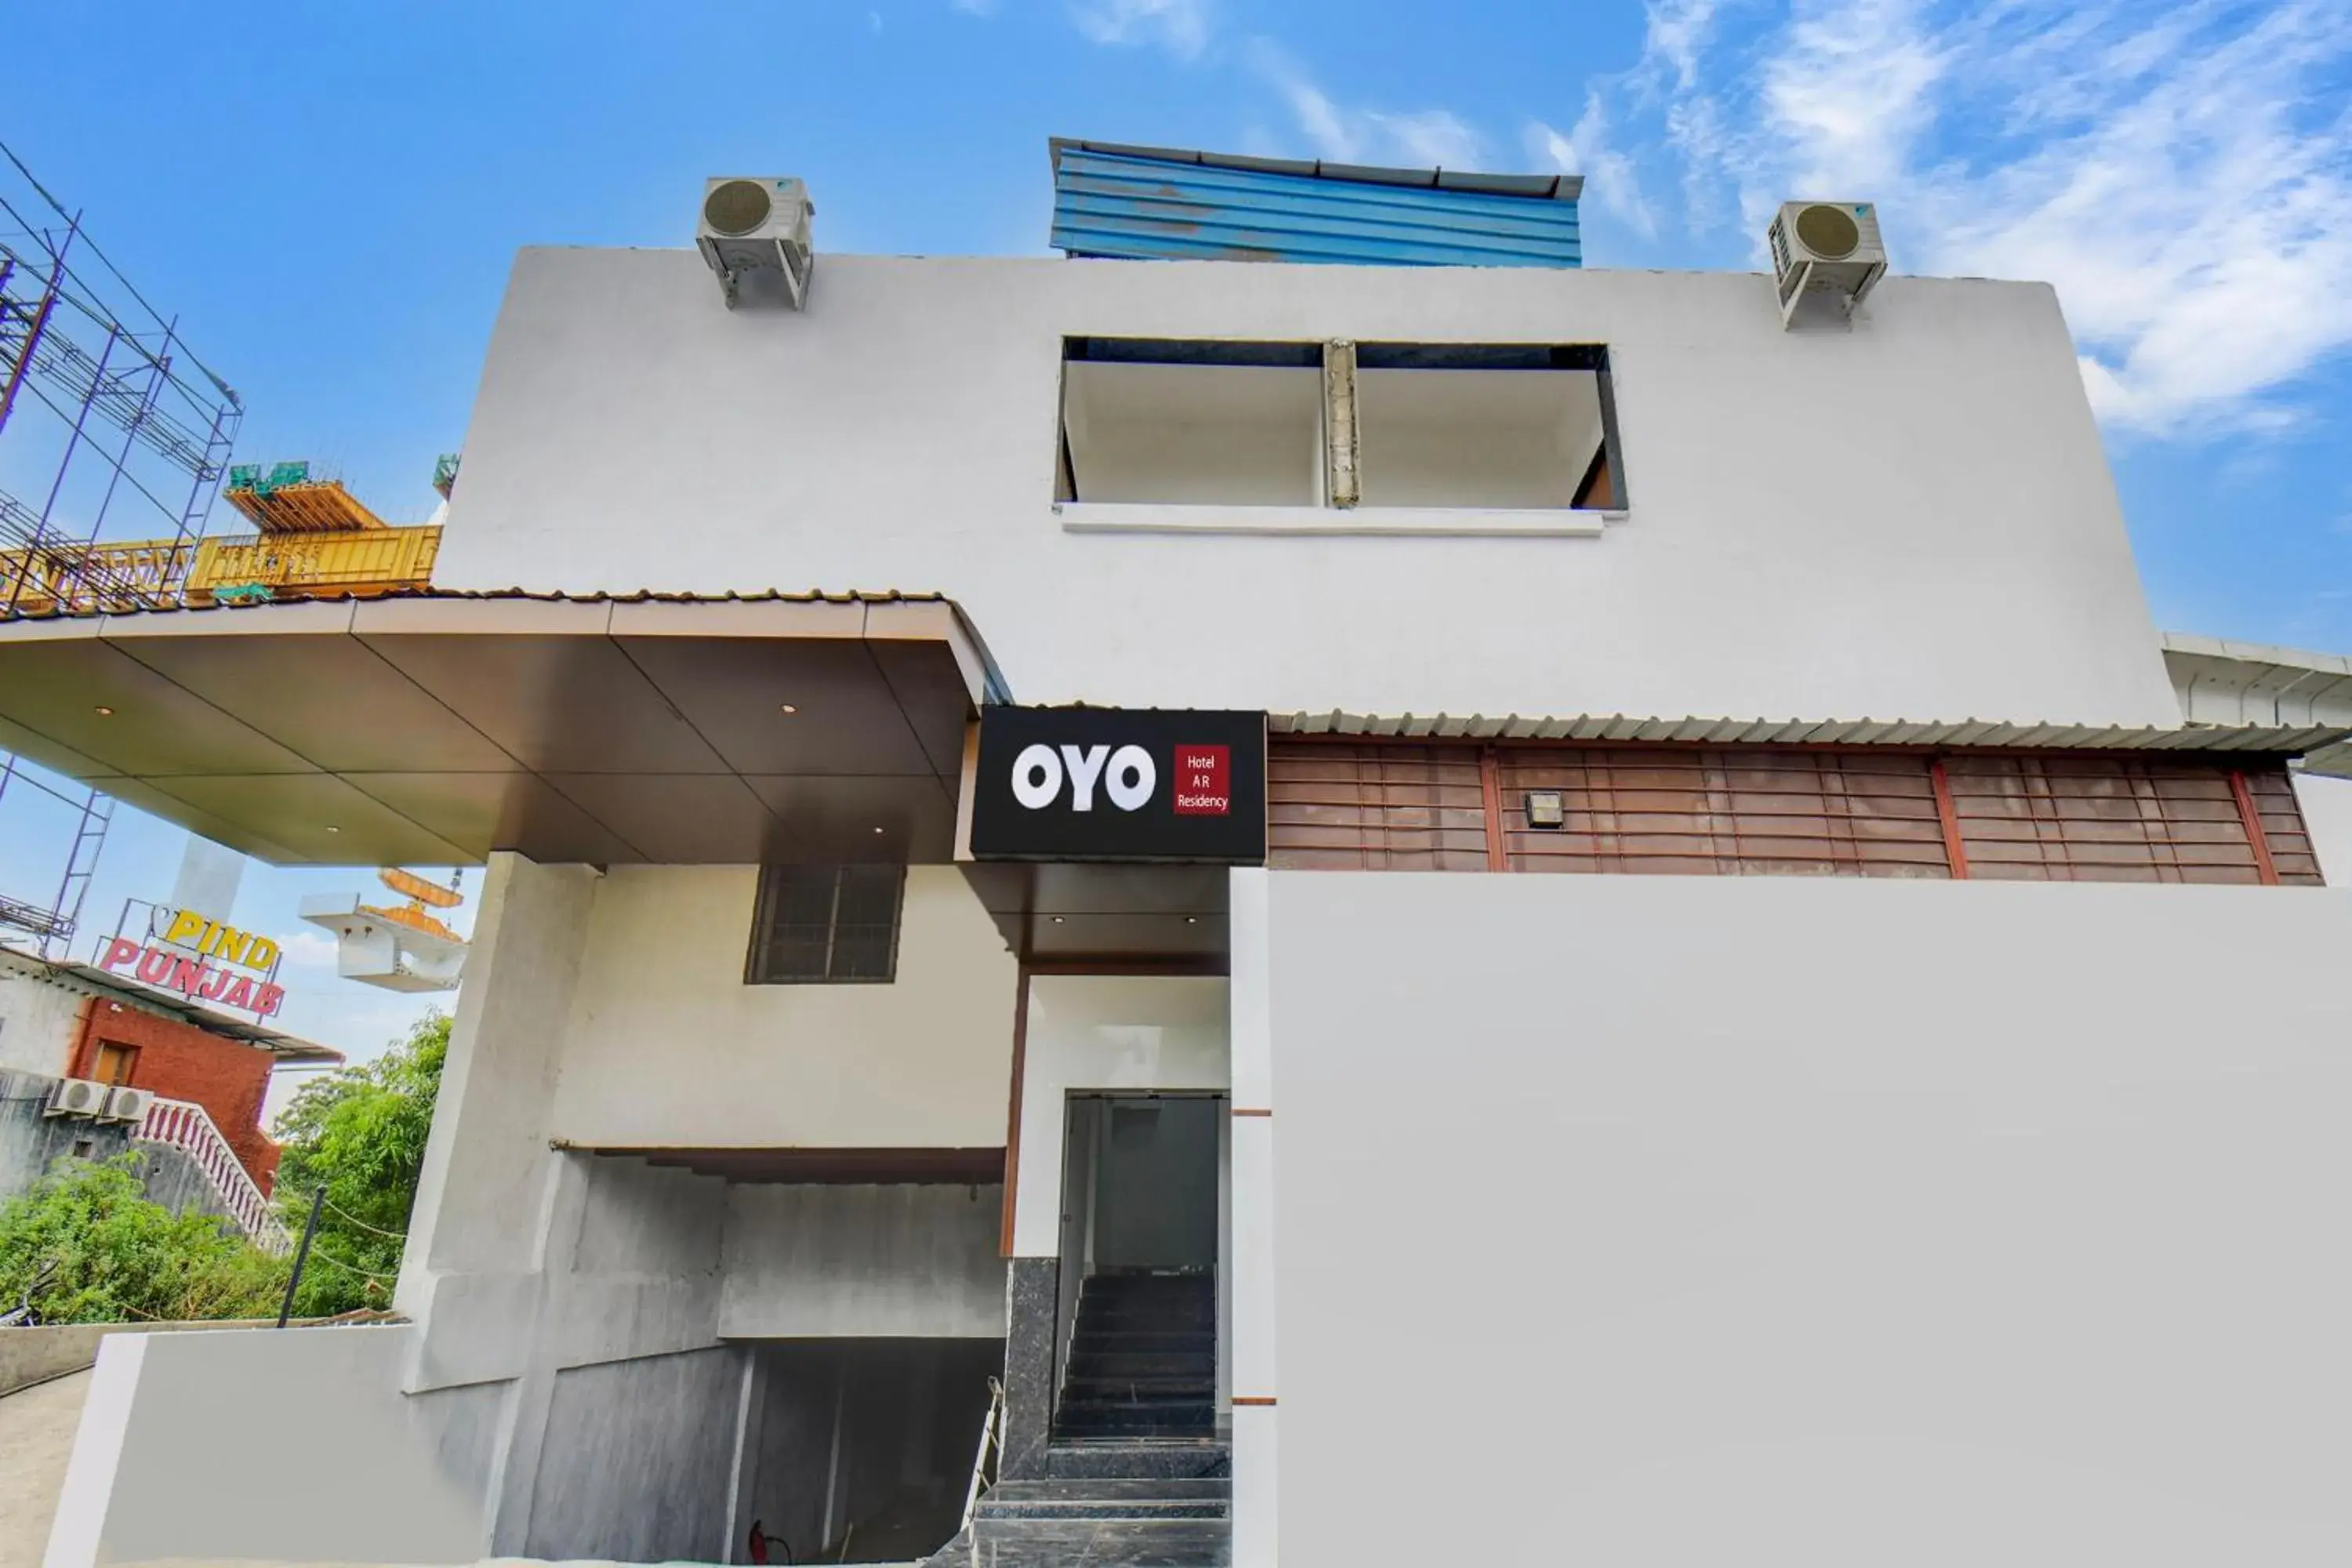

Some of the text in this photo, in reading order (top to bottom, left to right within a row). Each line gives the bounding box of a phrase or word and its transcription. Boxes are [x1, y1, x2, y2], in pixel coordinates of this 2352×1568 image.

[1011, 743, 1156, 811] OYO
[1187, 755, 1214, 769] Hotel
[1178, 795, 1229, 811] Residency
[165, 909, 279, 970] PIND
[99, 937, 284, 1014] PUNJAB
